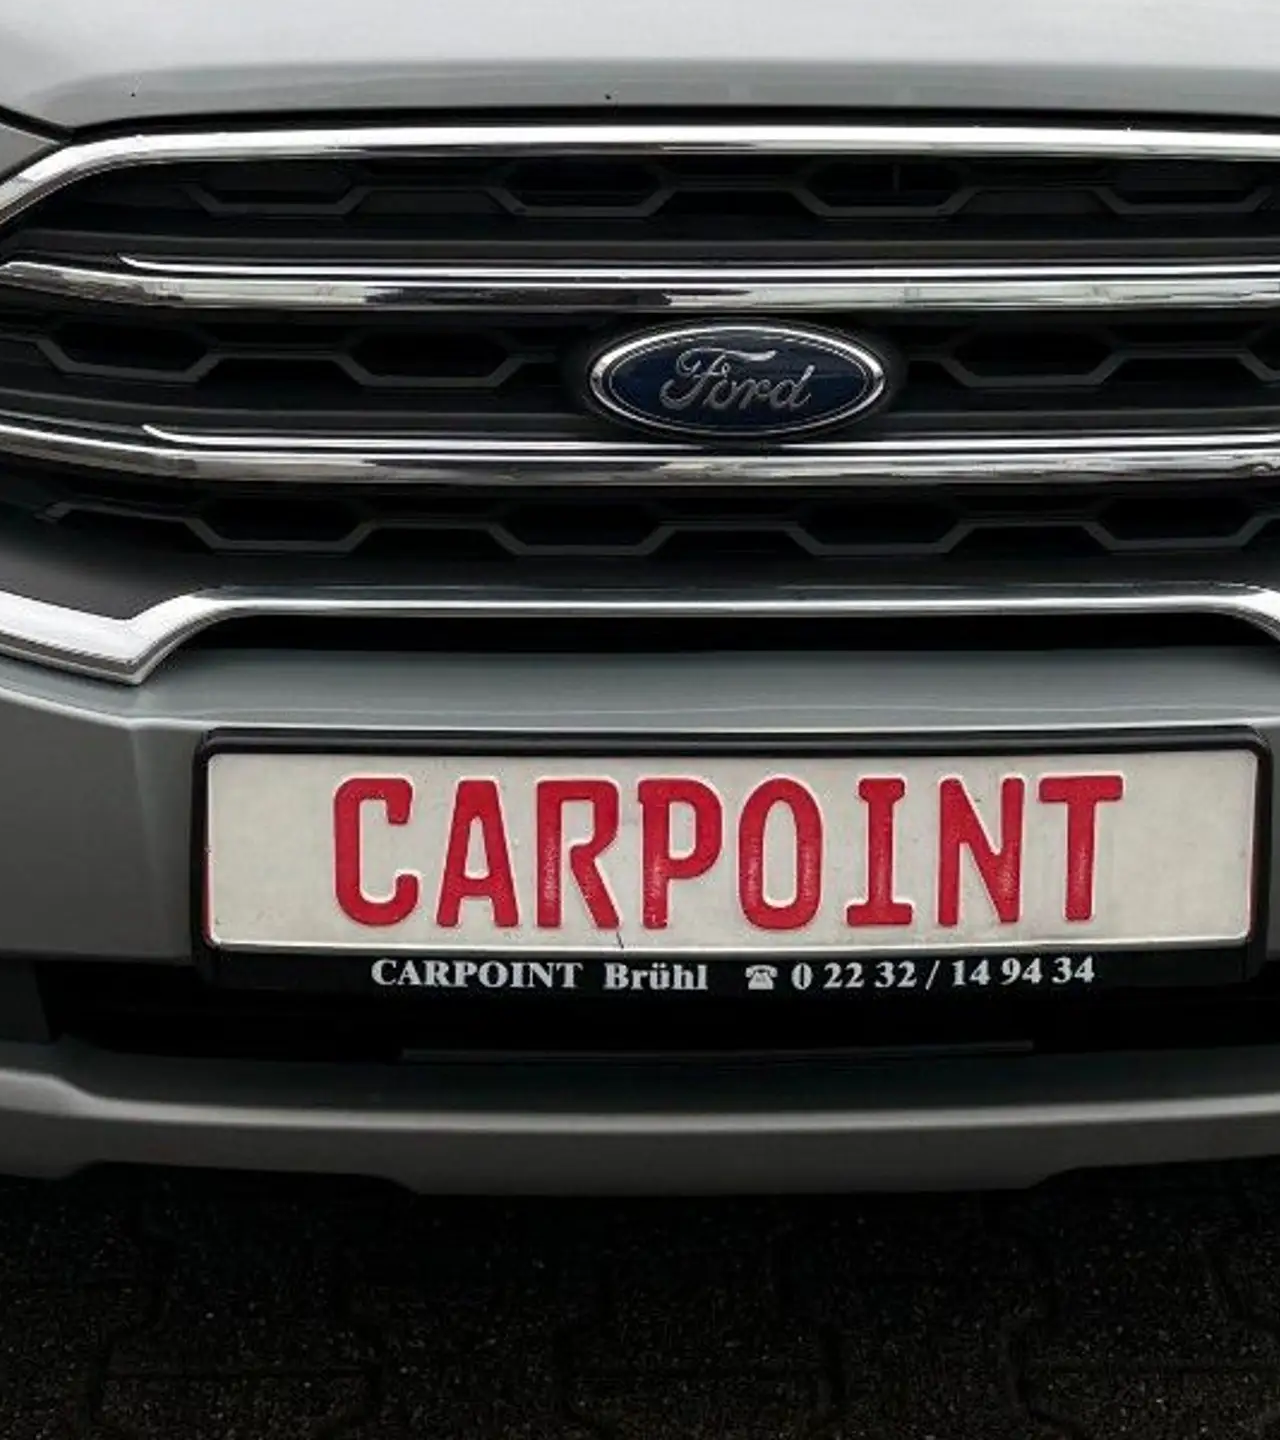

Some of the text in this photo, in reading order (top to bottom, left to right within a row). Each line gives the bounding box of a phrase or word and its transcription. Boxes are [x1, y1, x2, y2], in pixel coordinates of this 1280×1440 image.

[659, 348, 815, 410] Ford
[333, 775, 1123, 931] CARPOINT
[371, 959, 583, 988] CARPOINT
[604, 962, 708, 990] Brühl
[791, 963, 813, 990] 0
[823, 962, 865, 989] 22
[874, 960, 917, 988] 32
[952, 959, 991, 986] 14
[1001, 957, 1043, 985] 94
[1052, 956, 1095, 984] 34
